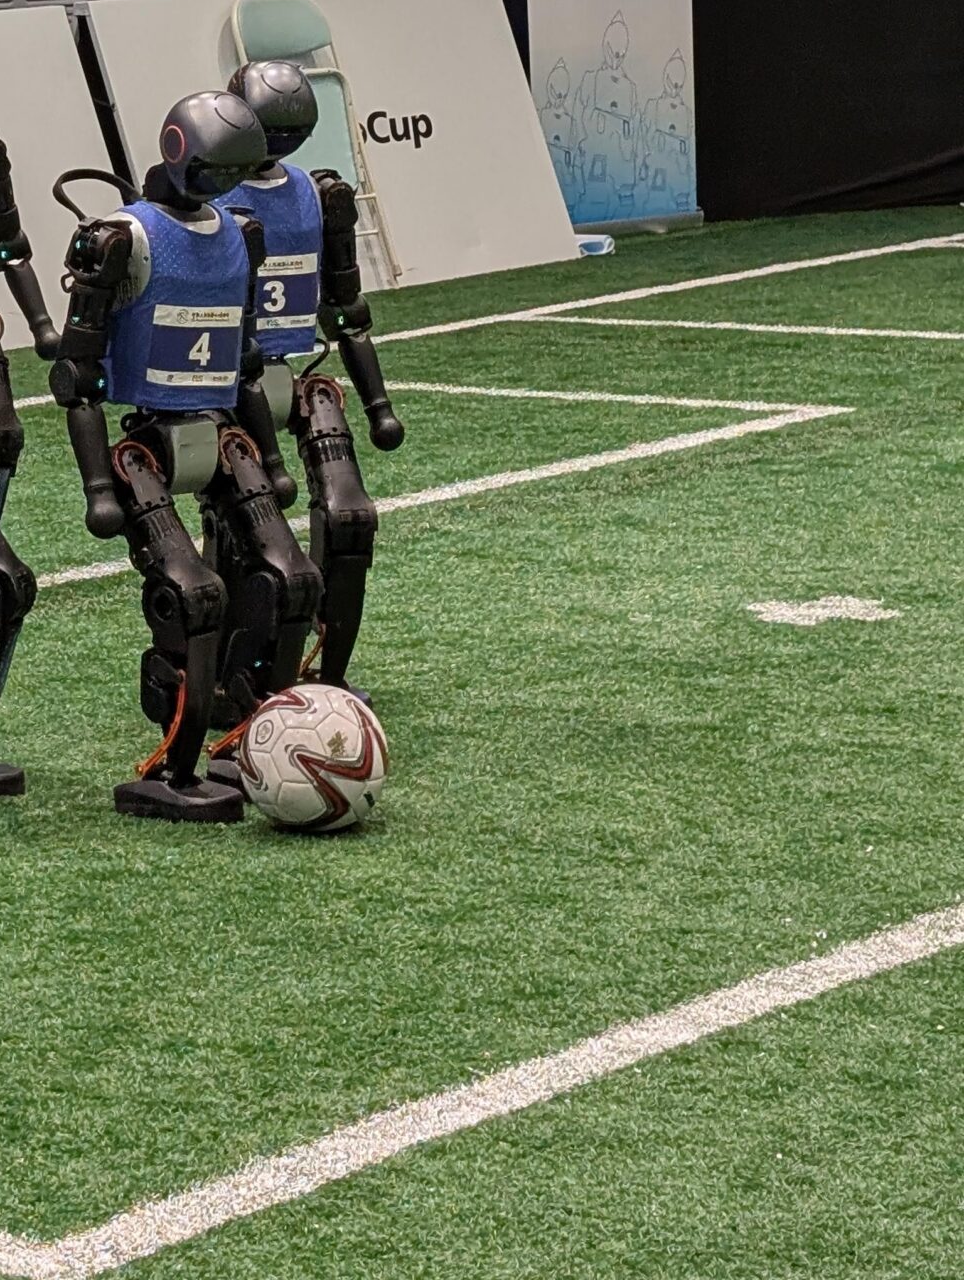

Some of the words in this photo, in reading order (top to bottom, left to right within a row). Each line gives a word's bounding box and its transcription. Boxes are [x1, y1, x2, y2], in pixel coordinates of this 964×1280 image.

[358, 111, 432, 149] Cup
[263, 281, 286, 312] 3
[188, 332, 211, 366] 4
